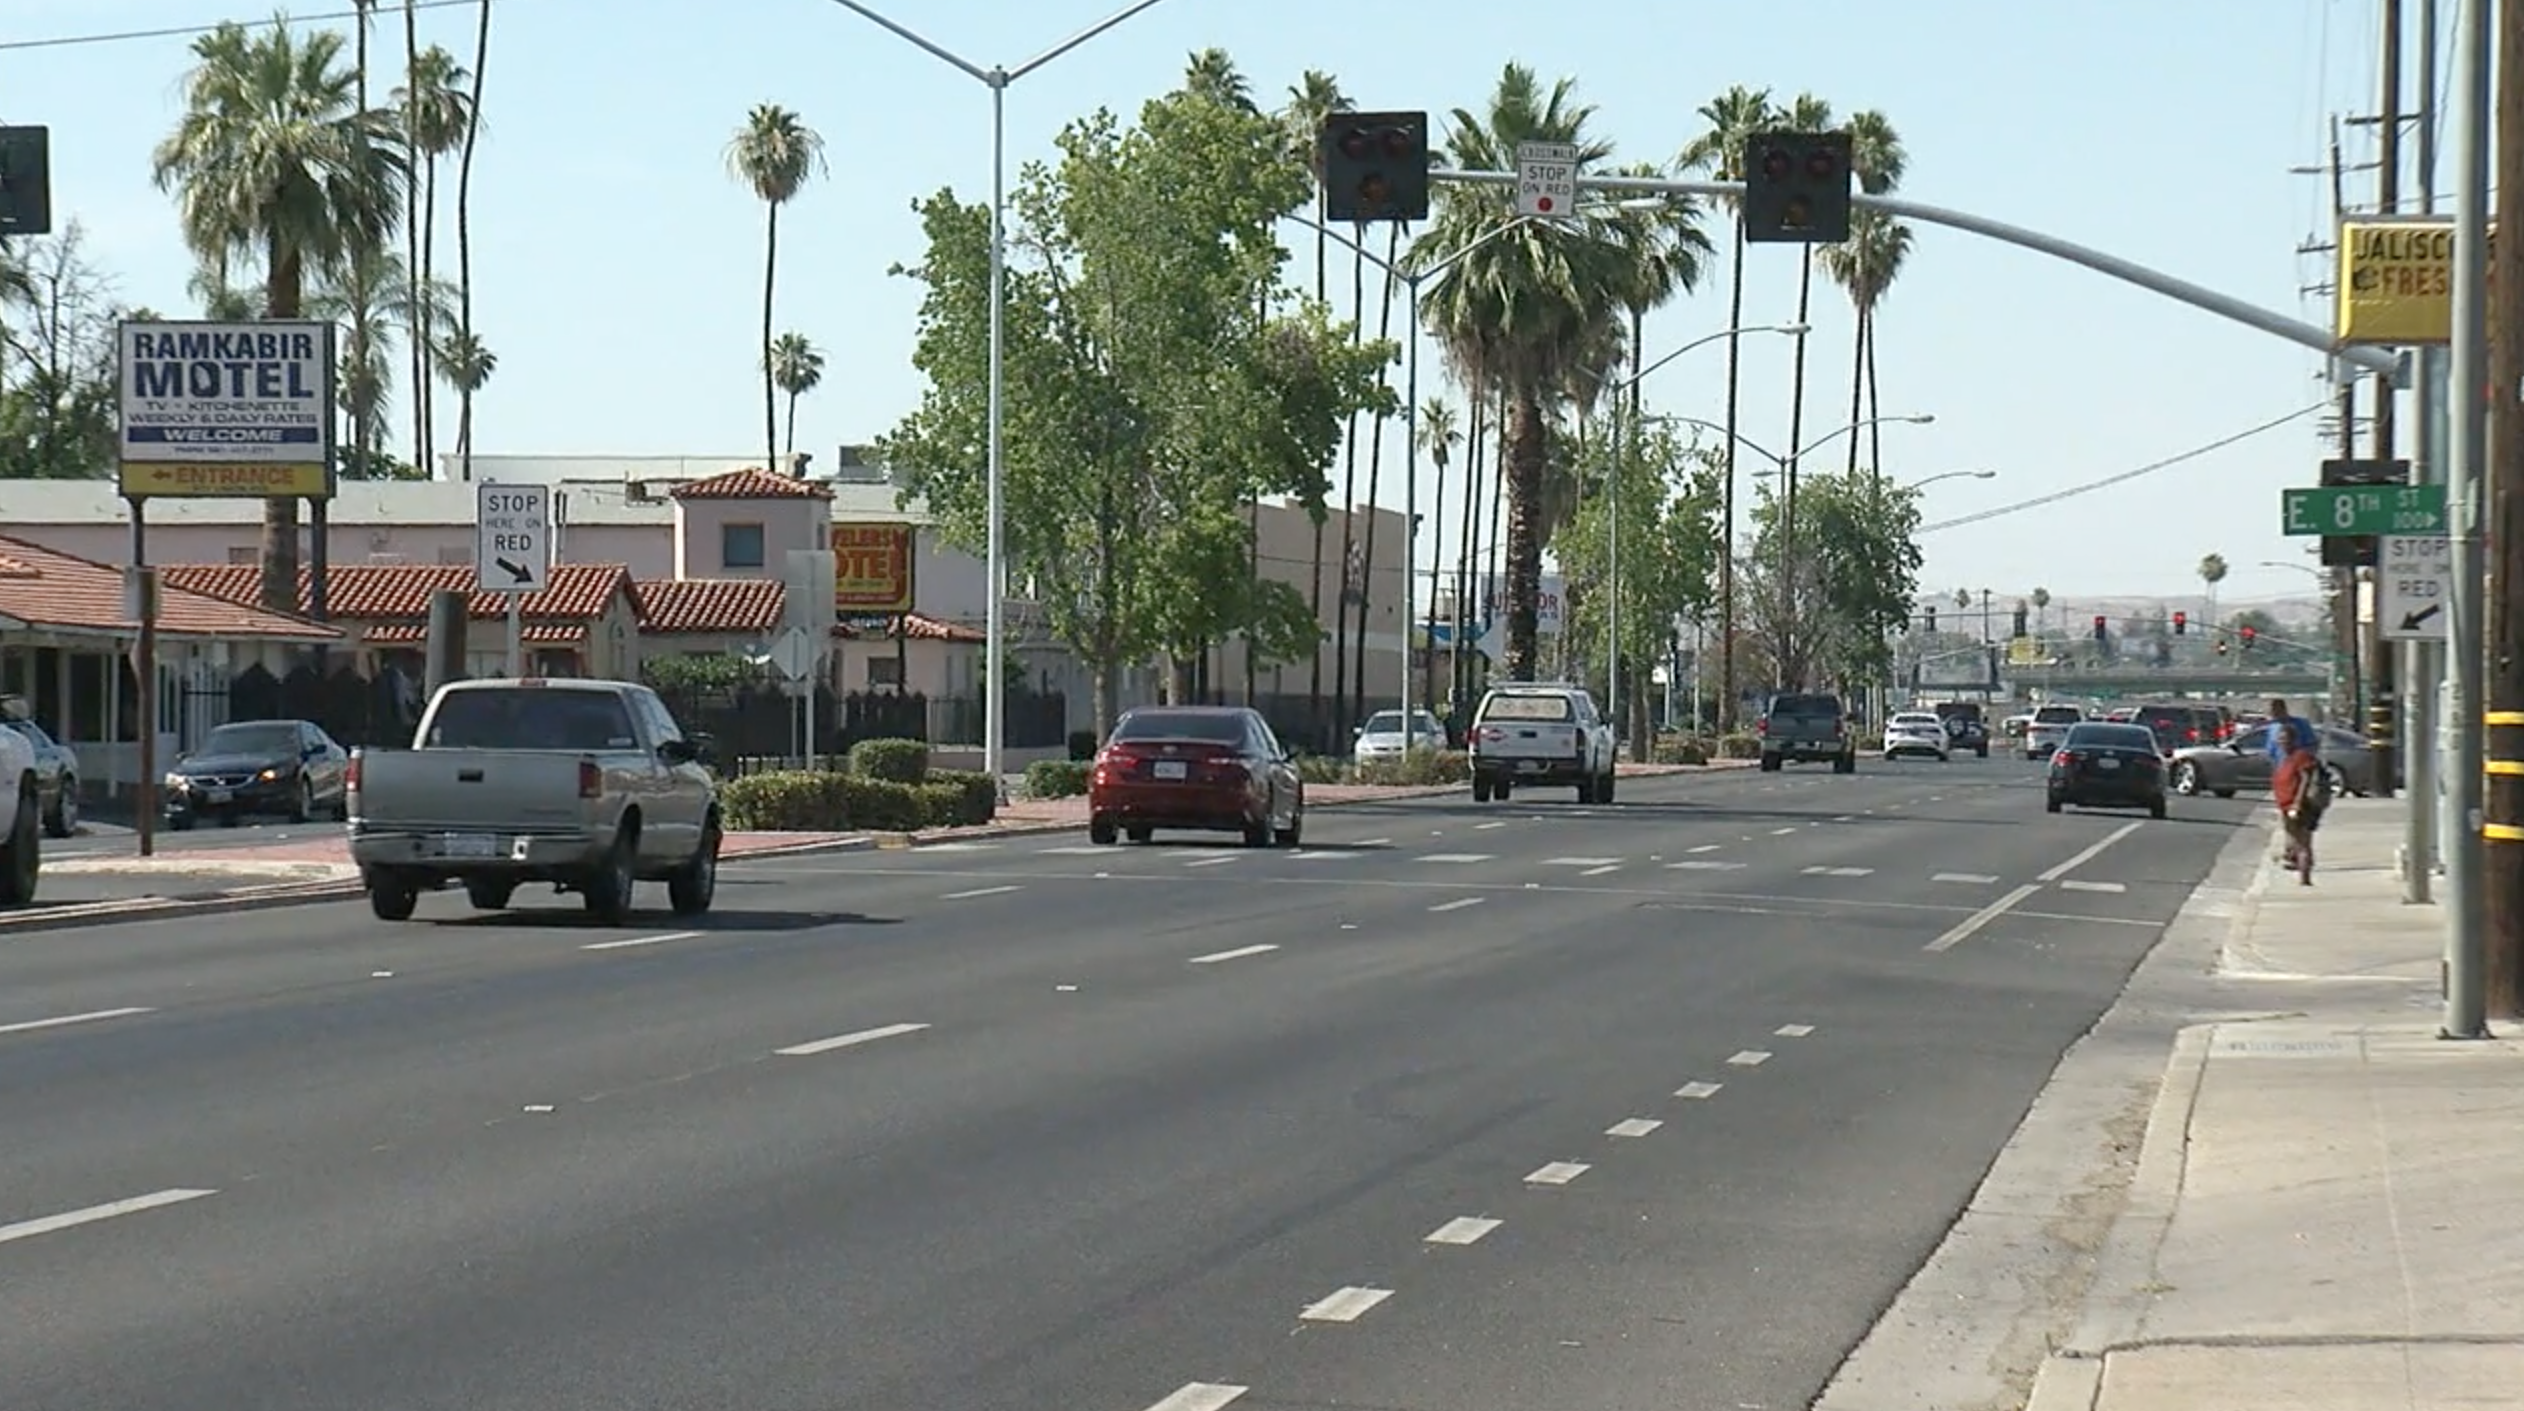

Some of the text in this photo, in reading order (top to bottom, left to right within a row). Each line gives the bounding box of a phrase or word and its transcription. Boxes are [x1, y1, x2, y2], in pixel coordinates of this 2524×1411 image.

[1528, 165, 1567, 180] STOP
[1523, 182, 1571, 195] ON RED
[2355, 230, 2455, 261] JALISC
[134, 332, 314, 360] RAMKABIR
[134, 361, 315, 398] MOTEL
[146, 401, 300, 412] TV KITCHENETTE
[129, 413, 196, 424] WEEKLY
[215, 413, 261, 424] DAILY
[263, 413, 317, 424] RATES
[162, 428, 284, 442] WELCOME
[176, 467, 295, 485] ENTRANCE
[488, 494, 539, 512] STOP
[2335, 494, 2381, 528] 8TH
[2398, 489, 2419, 508] ST
[485, 518, 542, 529] HERE ON
[494, 534, 532, 551] RED
[2391, 539, 2448, 557] STOP
[2399, 580, 2439, 597] RED
